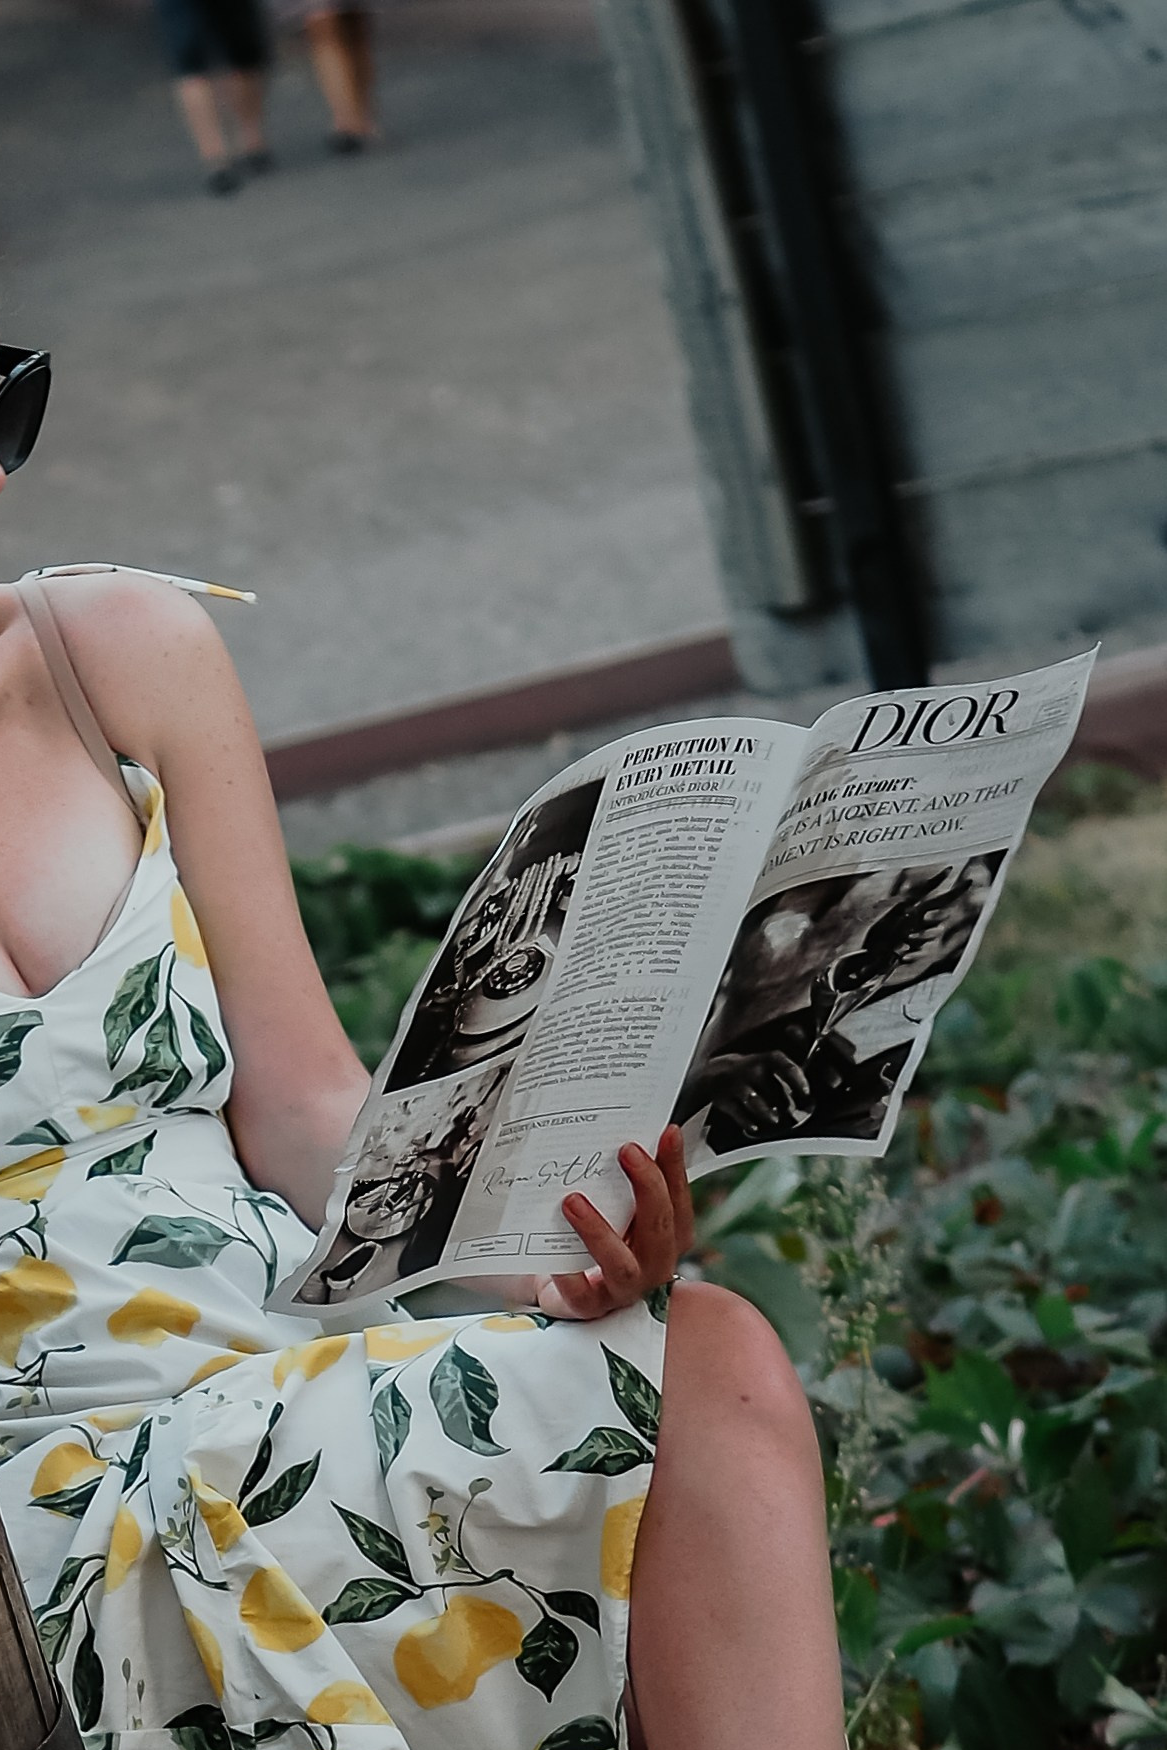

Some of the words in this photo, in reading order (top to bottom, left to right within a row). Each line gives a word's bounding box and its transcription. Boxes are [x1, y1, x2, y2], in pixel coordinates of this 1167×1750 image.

[845, 690, 1020, 755] DIOR
[623, 736, 732, 769] PERFECTION
[734, 737, 758, 754] IN
[616, 764, 668, 792] EVERY
[669, 759, 737, 778] DETAIL
[842, 776, 917, 799] REPORT:
[609, 781, 685, 810] INTRODUCING
[687, 781, 720, 793] DIOR
[792, 816, 811, 836] IS
[809, 814, 822, 829] A
[921, 791, 969, 812] AND
[973, 777, 1024, 803] THAT
[823, 833, 844, 850] IS
[843, 824, 913, 846] RIGHT
[913, 816, 964, 838] NOW.
